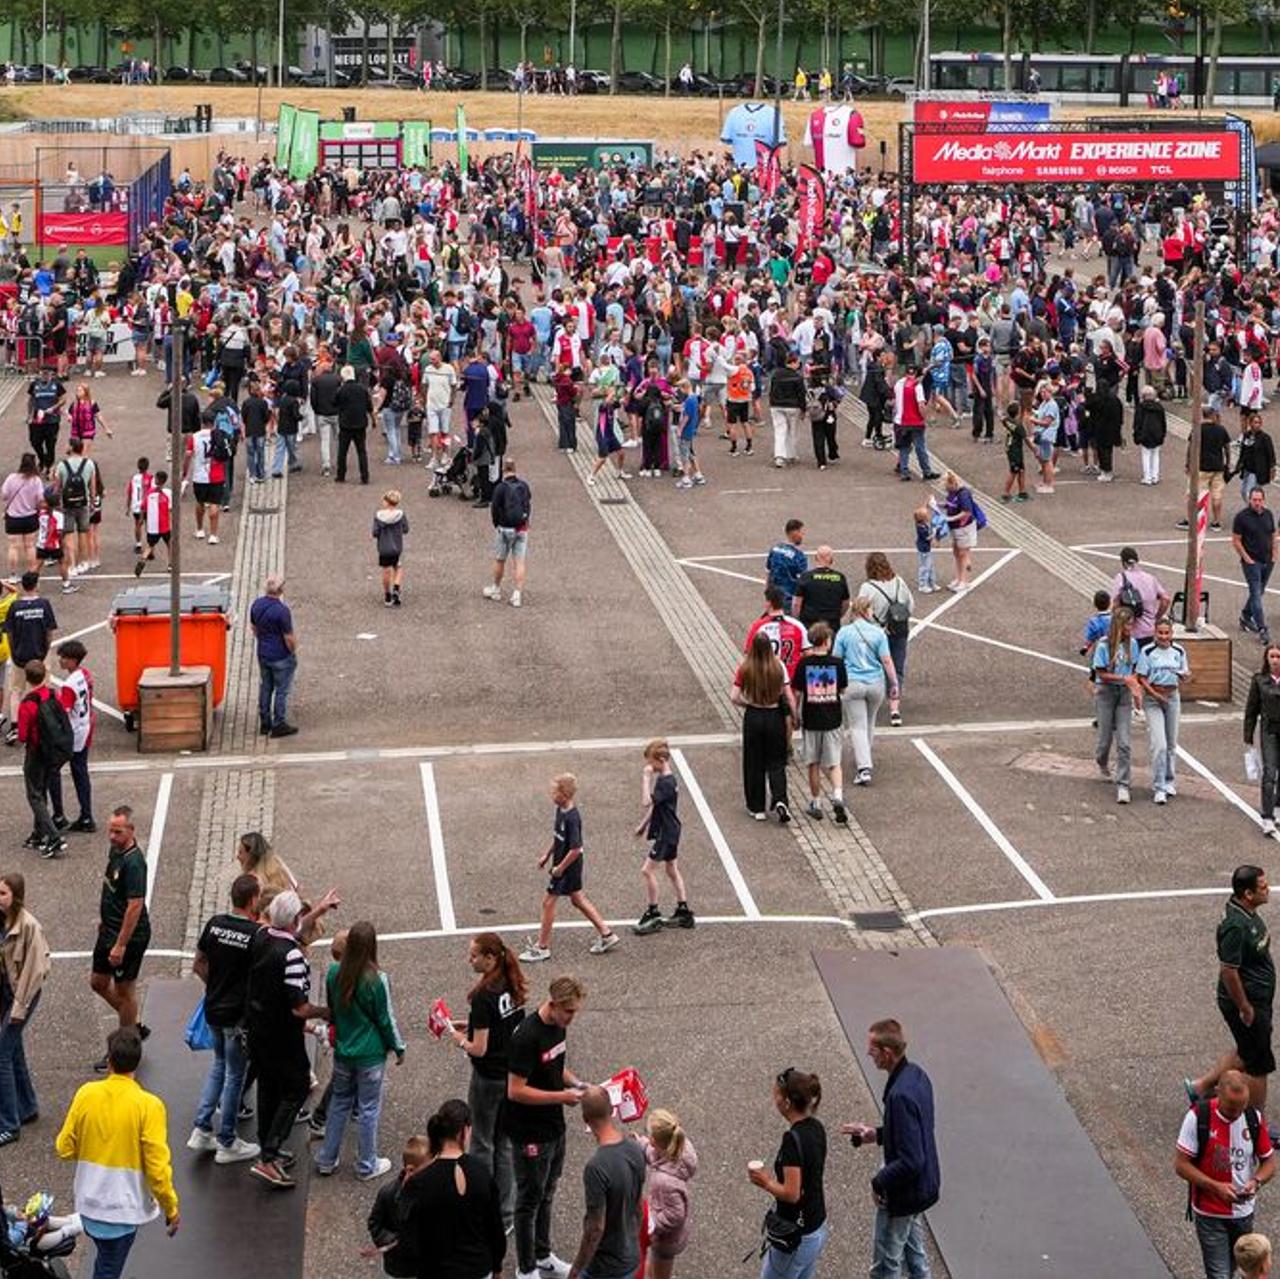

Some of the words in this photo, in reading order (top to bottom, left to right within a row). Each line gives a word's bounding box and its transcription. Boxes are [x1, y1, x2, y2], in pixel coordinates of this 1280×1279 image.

[1071, 142, 1173, 160] EXPERIENCE
[1174, 141, 1222, 160] ZONE
[1036, 166, 1084, 176] SAMSUNG
[1150, 165, 1173, 175] TCL
